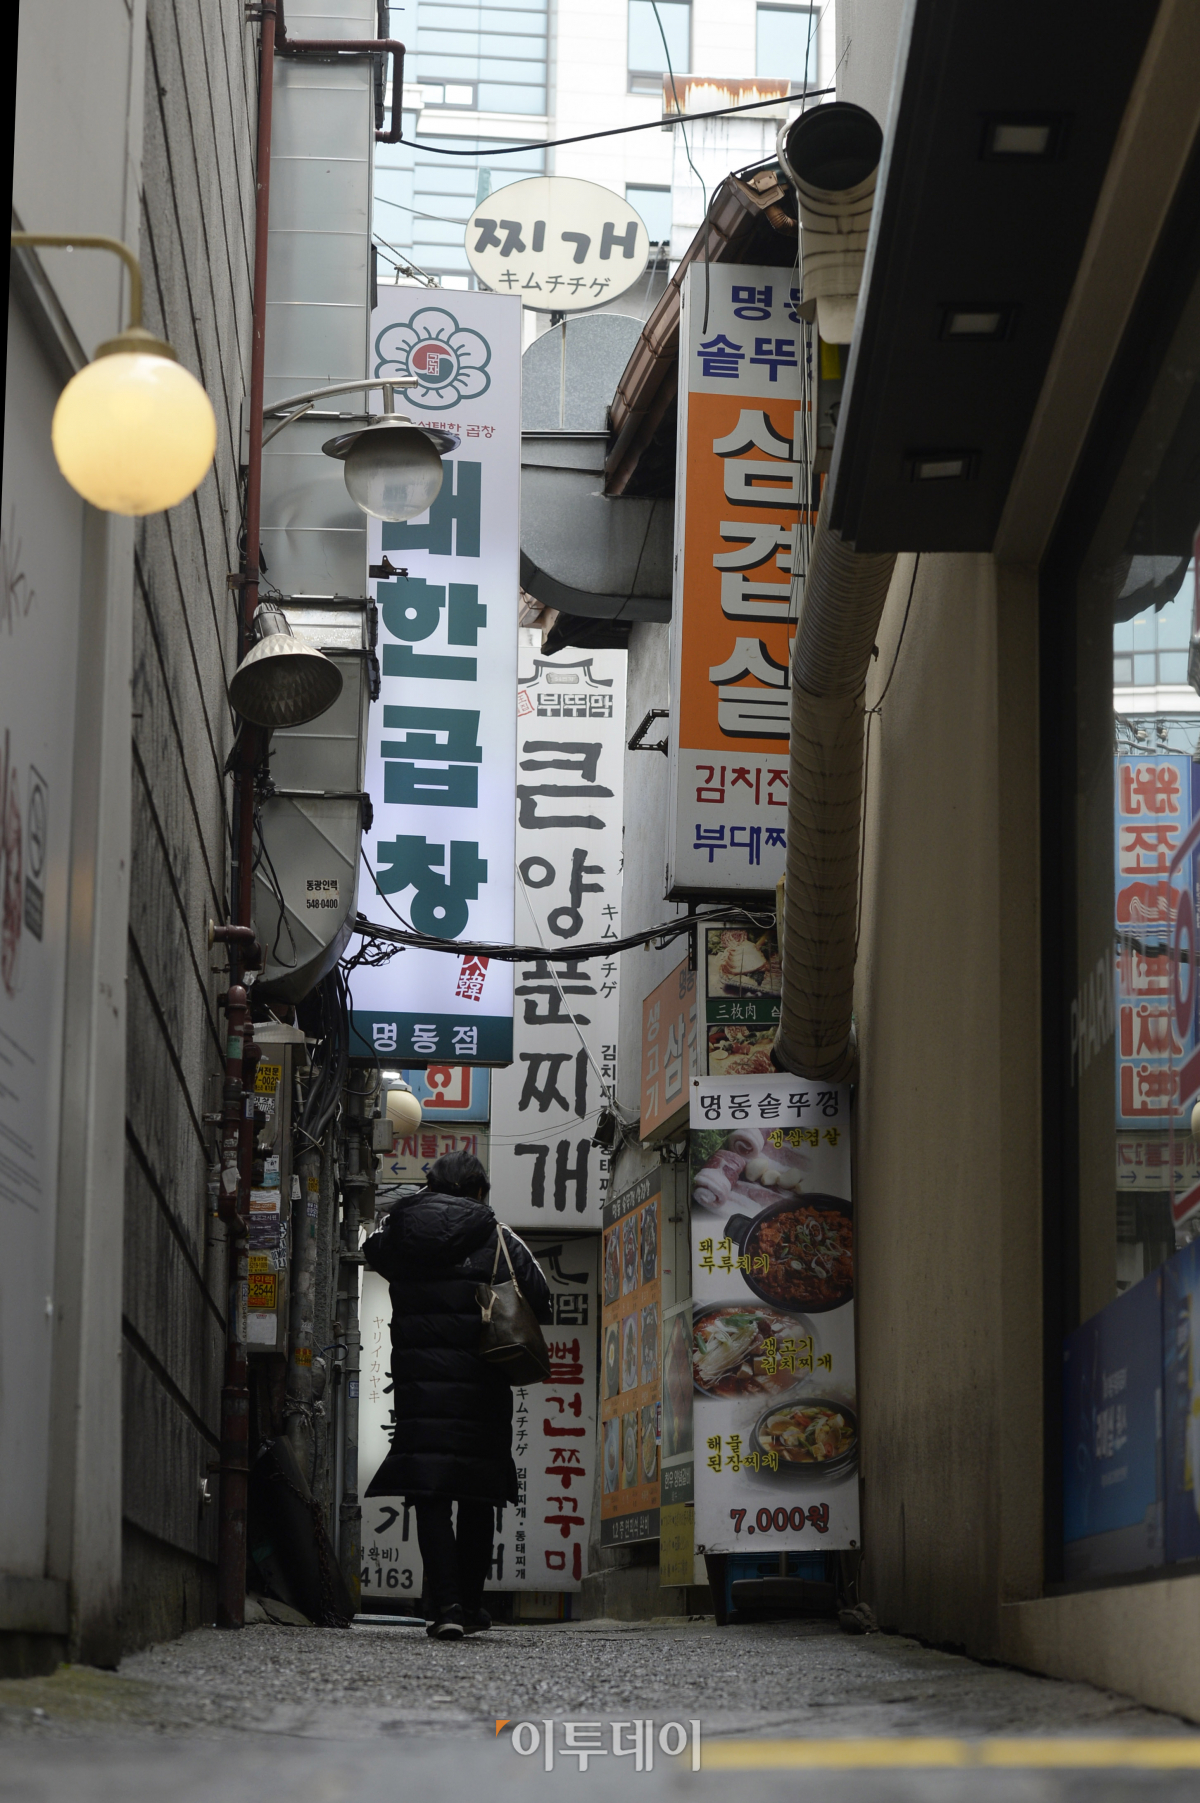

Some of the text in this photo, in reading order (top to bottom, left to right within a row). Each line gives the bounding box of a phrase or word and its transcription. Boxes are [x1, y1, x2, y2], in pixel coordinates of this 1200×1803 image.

[473, 218, 639, 264] 찌개
[498, 269, 611, 298] キムチチゲ
[697, 334, 812, 382] 솥뚜
[466, 425, 496, 439] 곱창
[537, 693, 613, 717] 부뚜막
[306, 880, 338, 891] 동광인력
[600, 904, 619, 998] キムチゲ
[716, 1003, 757, 1020] 三枚肉
[371, 1022, 480, 1056] 명동점
[645, 1000, 661, 1120] 생고기
[700, 1090, 840, 1121] 명동솥뚜껑
[768, 1128, 841, 1148] 생삼겹살
[699, 1237, 733, 1255] 돼지
[699, 1253, 770, 1275] 두루치기
[761, 1337, 814, 1356] 생고기
[368, 1316, 384, 1403] ヤリイカヤキ
[761, 1353, 833, 1375] 김치찌개
[515, 1387, 529, 1456] キムチチゲ
[707, 1435, 743, 1453] 해물
[707, 1452, 779, 1473] 된장찌개
[730, 1503, 830, 1535] 7,000원
[361, 1567, 413, 1589] 4163
